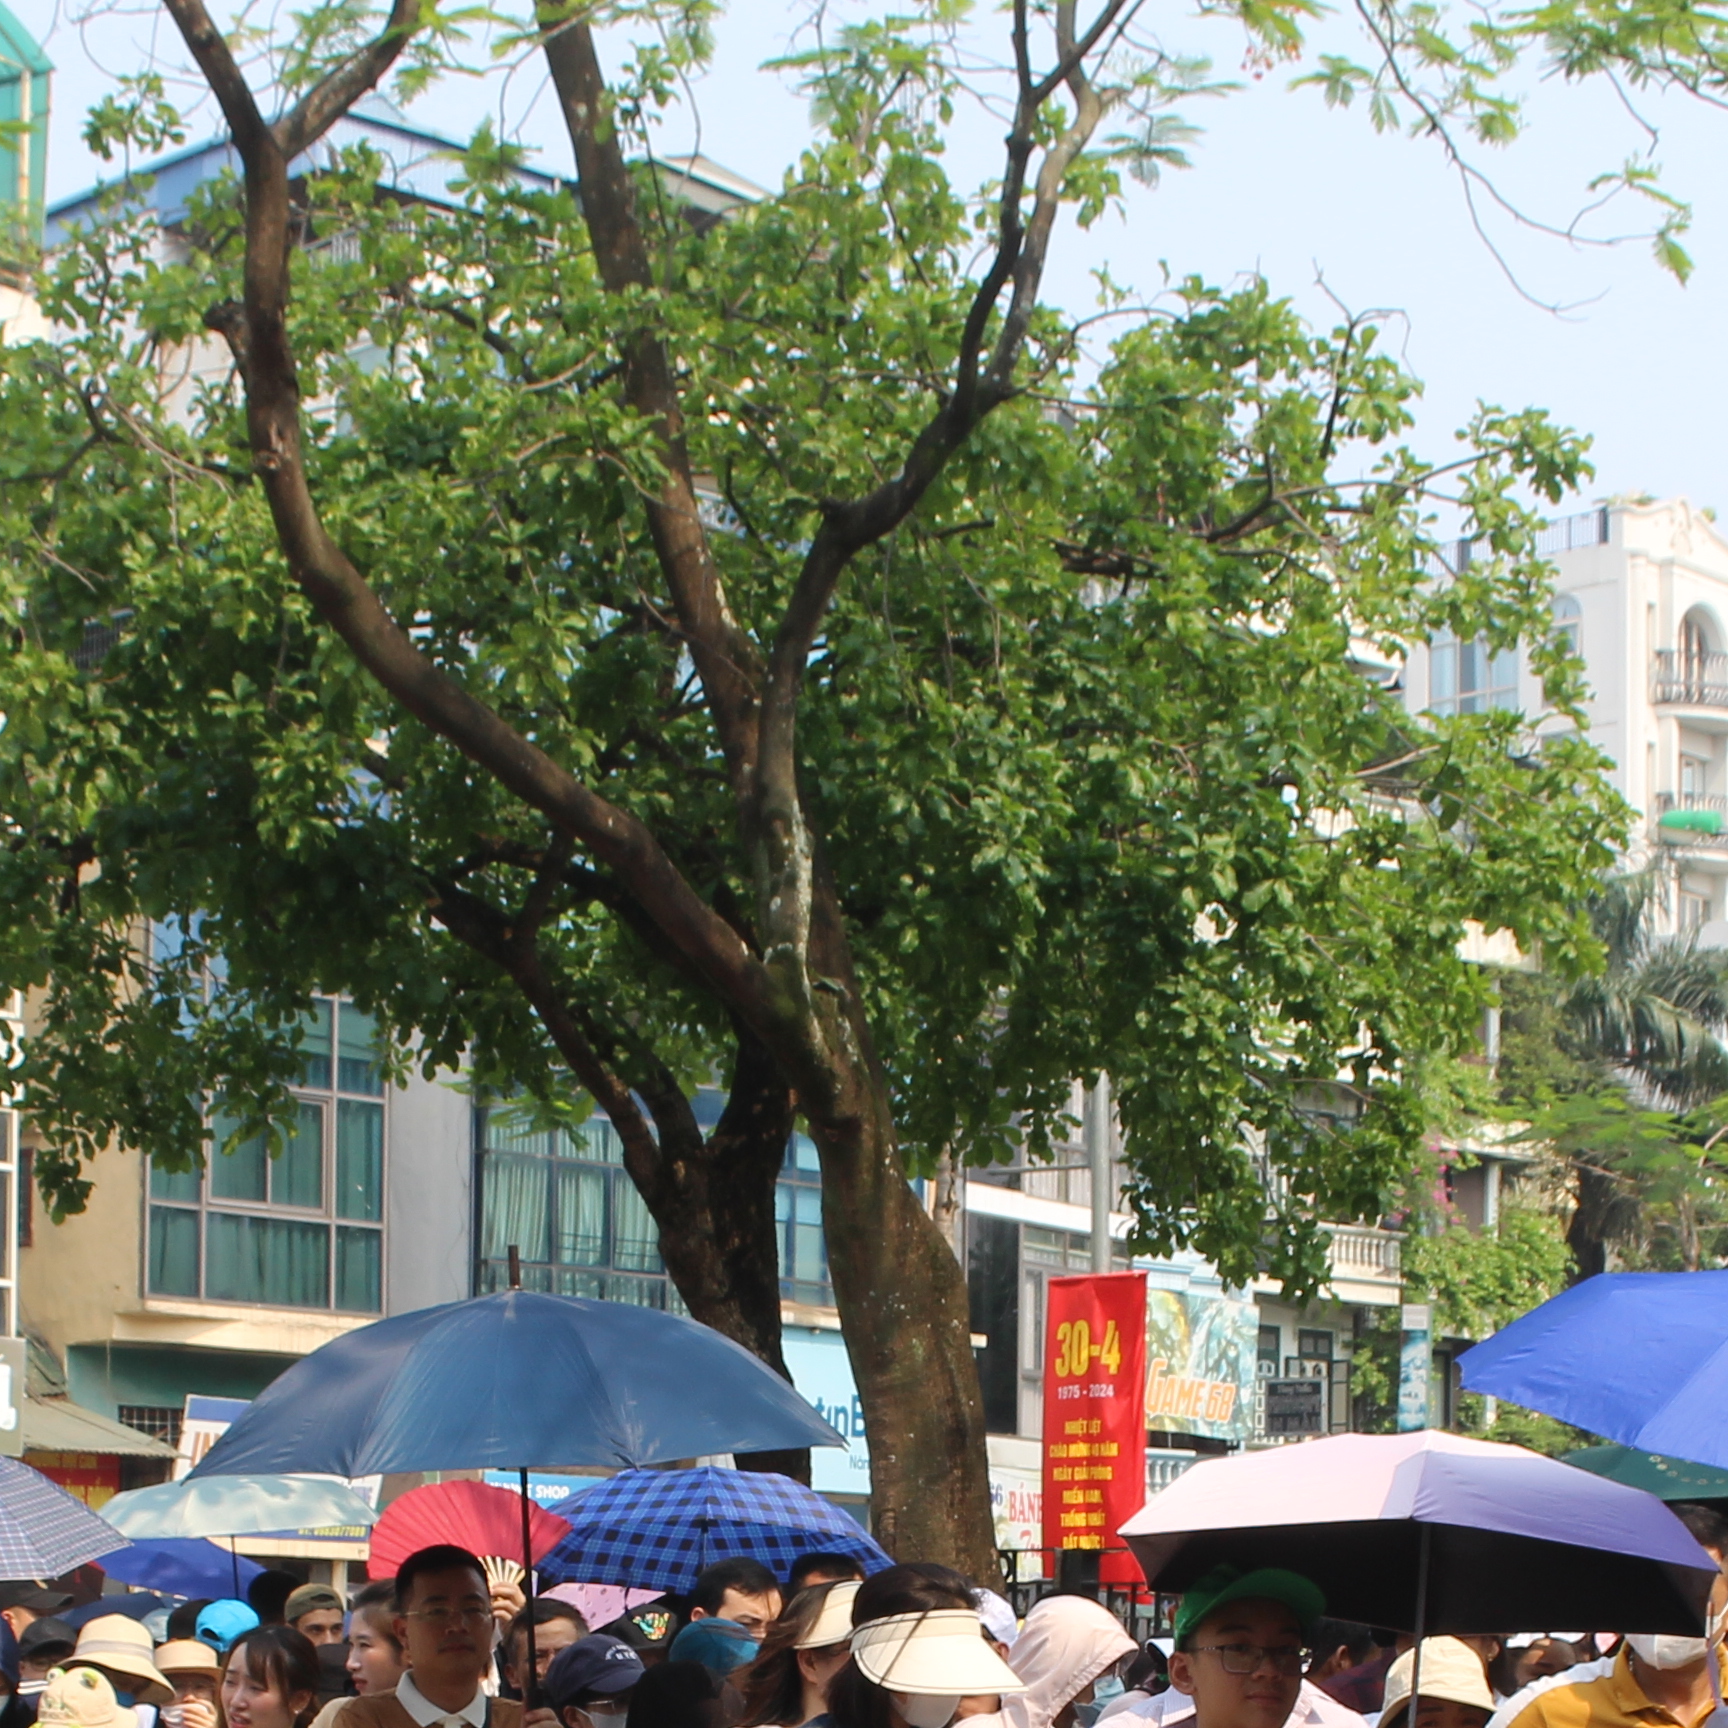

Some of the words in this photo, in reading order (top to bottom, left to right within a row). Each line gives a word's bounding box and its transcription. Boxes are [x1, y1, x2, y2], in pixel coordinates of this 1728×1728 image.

[1055, 1319, 1121, 1378] 30-4
[1057, 1385, 1080, 1399] 1975
[1089, 1384, 1114, 1398] 2024
[1145, 1357, 1207, 1419] GAME
[1204, 1381, 1237, 1423] 68
[535, 1484, 570, 1499] SHOP
